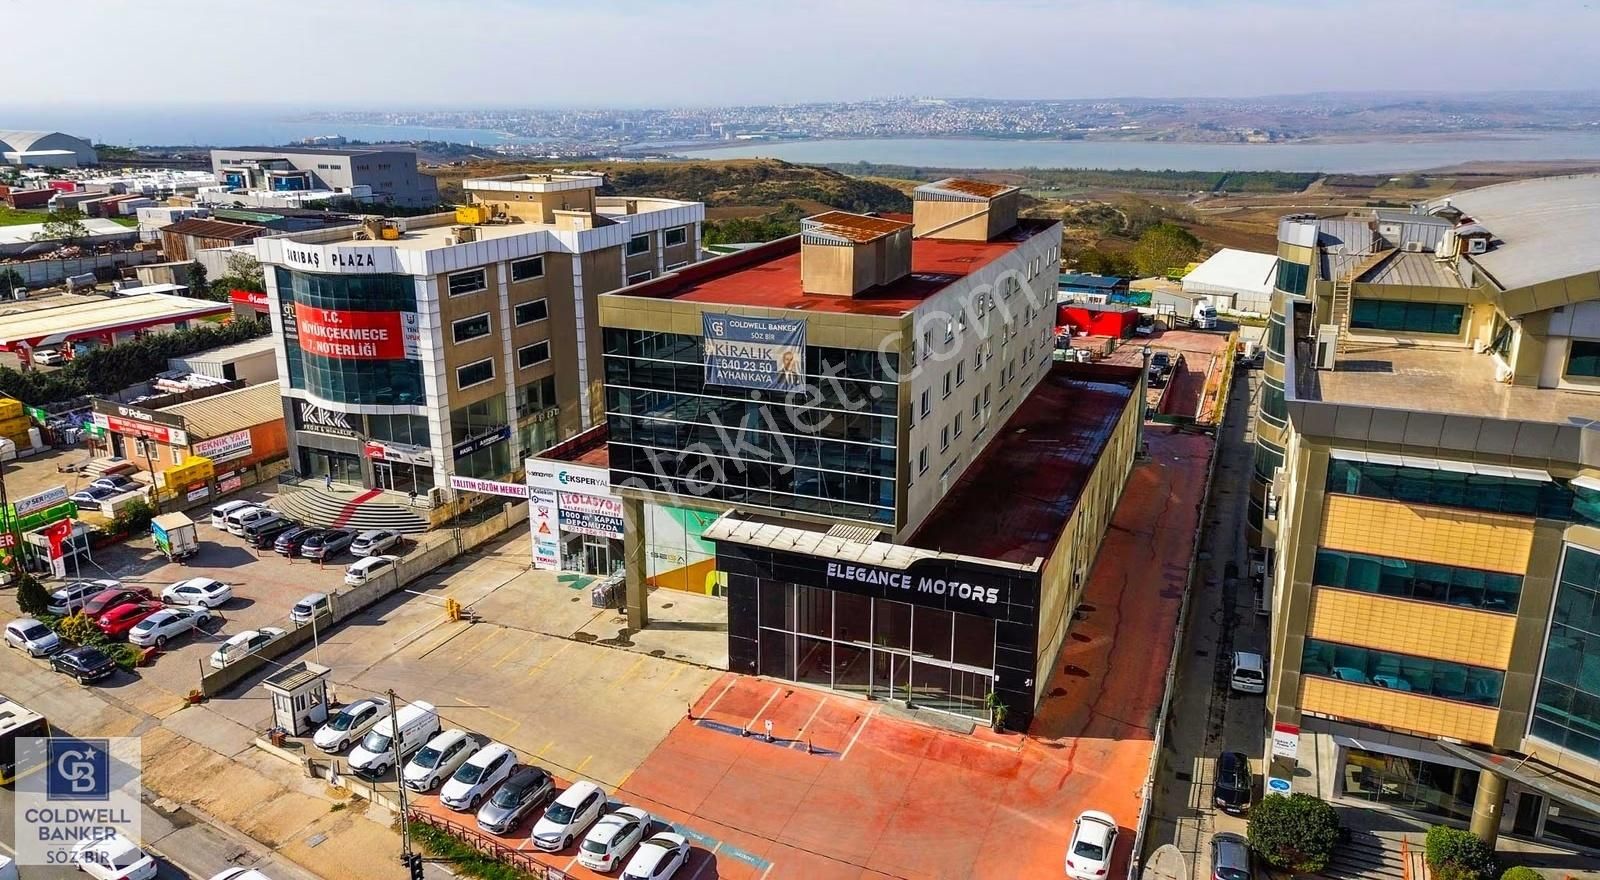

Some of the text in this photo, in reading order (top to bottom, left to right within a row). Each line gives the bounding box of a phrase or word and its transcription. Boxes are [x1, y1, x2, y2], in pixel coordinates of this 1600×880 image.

[332, 253, 374, 266] PLAZA
[322, 310, 343, 324] T.C.
[729, 320, 797, 332] COLDWELL BANKER
[751, 331, 764, 339] SÖZ
[715, 341, 773, 360] KİRALIK
[721, 358, 772, 373] 640 23 50
[452, 479, 527, 496] YALITIM ÇÖZÜM MERKEZİ
[560, 510, 580, 519] 1000
[594, 515, 623, 526] KAPALI
[566, 518, 618, 532] DEPOMUZDA
[826, 562, 1000, 605] ELEGANCE MOTORS
